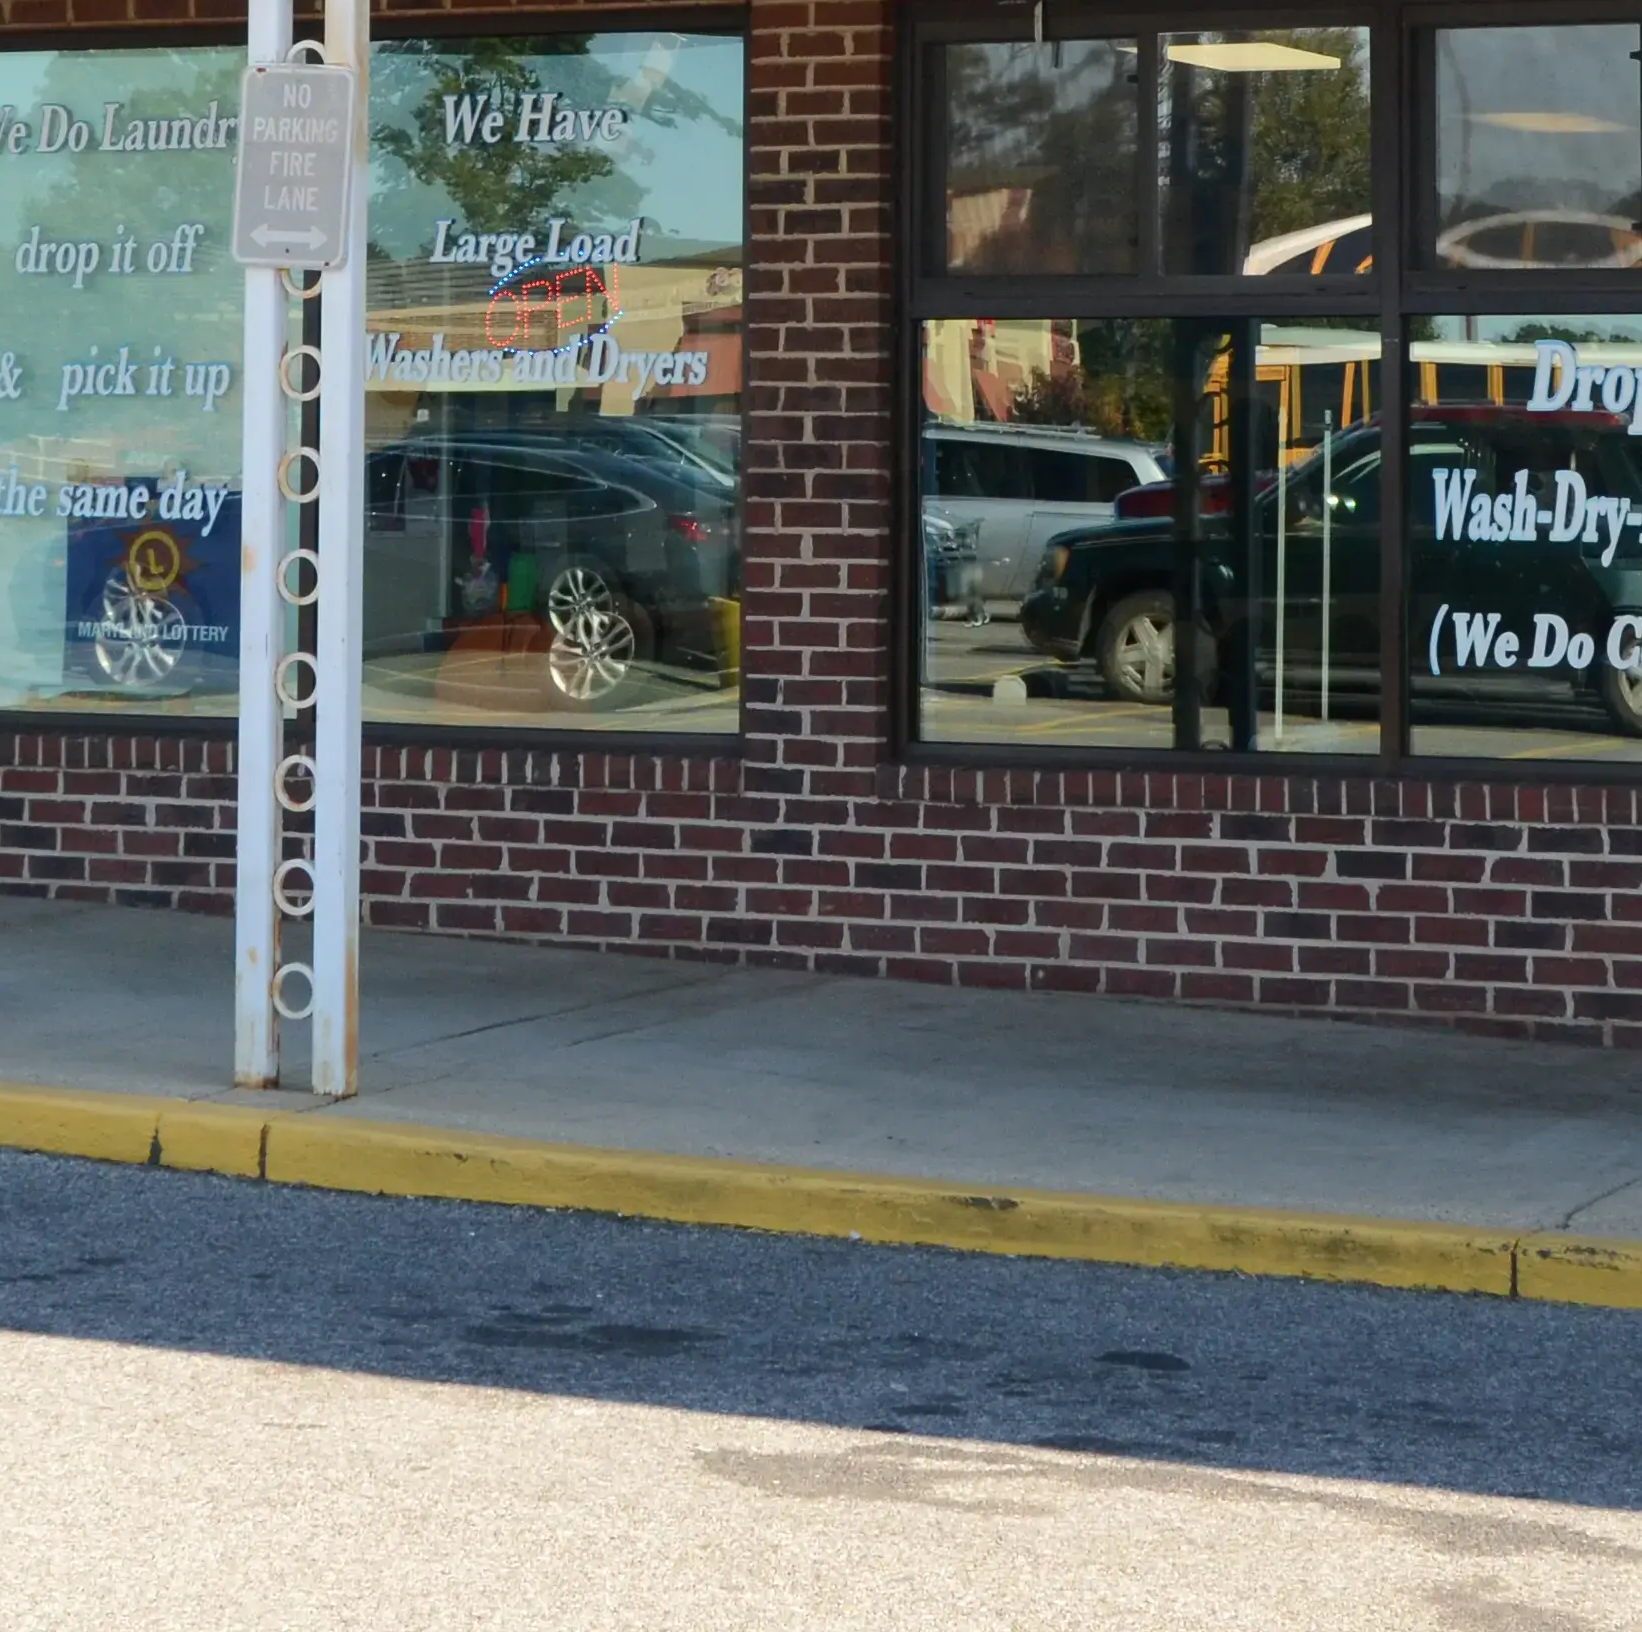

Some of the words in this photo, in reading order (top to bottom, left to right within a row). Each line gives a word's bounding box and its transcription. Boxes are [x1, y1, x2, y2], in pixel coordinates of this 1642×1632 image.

[283, 84, 311, 109] NO
[444, 95, 504, 144] We
[514, 92, 626, 142] Have
[36, 104, 88, 152] Do
[99, 100, 242, 164] Laundr
[253, 117, 338, 144] PARKING
[269, 152, 316, 177] FIRE
[263, 187, 318, 212] LANE
[15, 226, 99, 288] drop
[108, 225, 136, 273] it
[147, 224, 204, 272] off
[430, 219, 534, 278] Large
[544, 217, 643, 263] Load
[486, 262, 619, 347] OPEN
[56, 345, 137, 410] pick
[145, 345, 175, 396] it
[185, 361, 230, 411] up
[364, 333, 504, 383] Washers
[513, 334, 583, 383] and
[588, 333, 708, 400] Dryers
[57, 482, 150, 518] same
[159, 468, 228, 537] day
[78, 621, 157, 641] MARYLAND
[163, 623, 229, 643] LOTTERY
[1430, 604, 1519, 675] (We
[1529, 614, 1594, 670] Do
